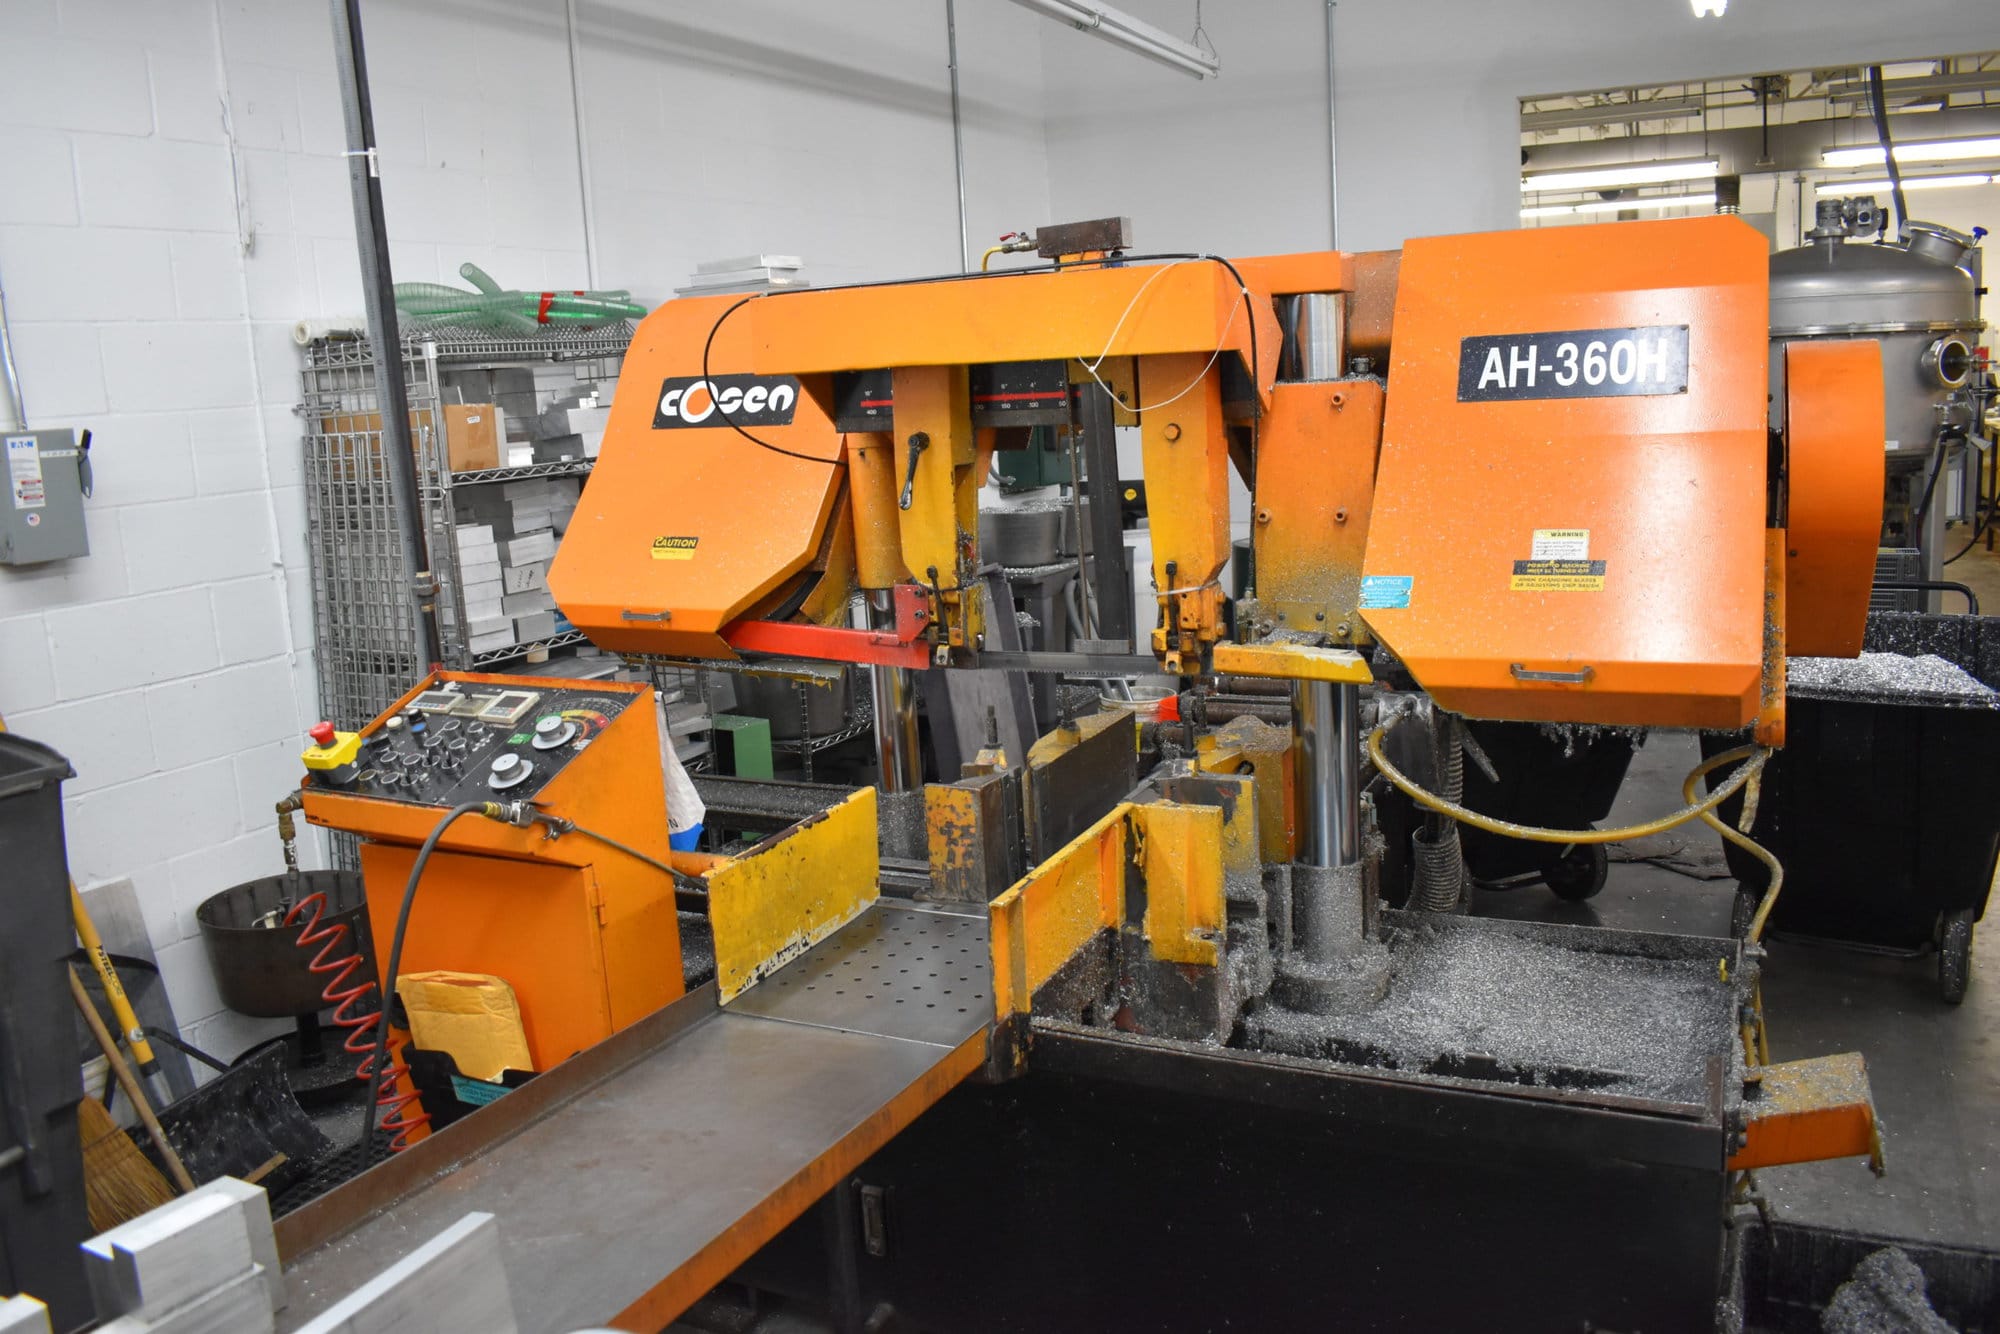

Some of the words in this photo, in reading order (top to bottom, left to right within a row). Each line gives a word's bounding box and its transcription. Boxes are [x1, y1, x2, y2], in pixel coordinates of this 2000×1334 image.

[1477, 338, 1668, 390] AH-360H
[655, 536, 697, 548] CAUTION
[1375, 578, 1403, 586] NOTICE
